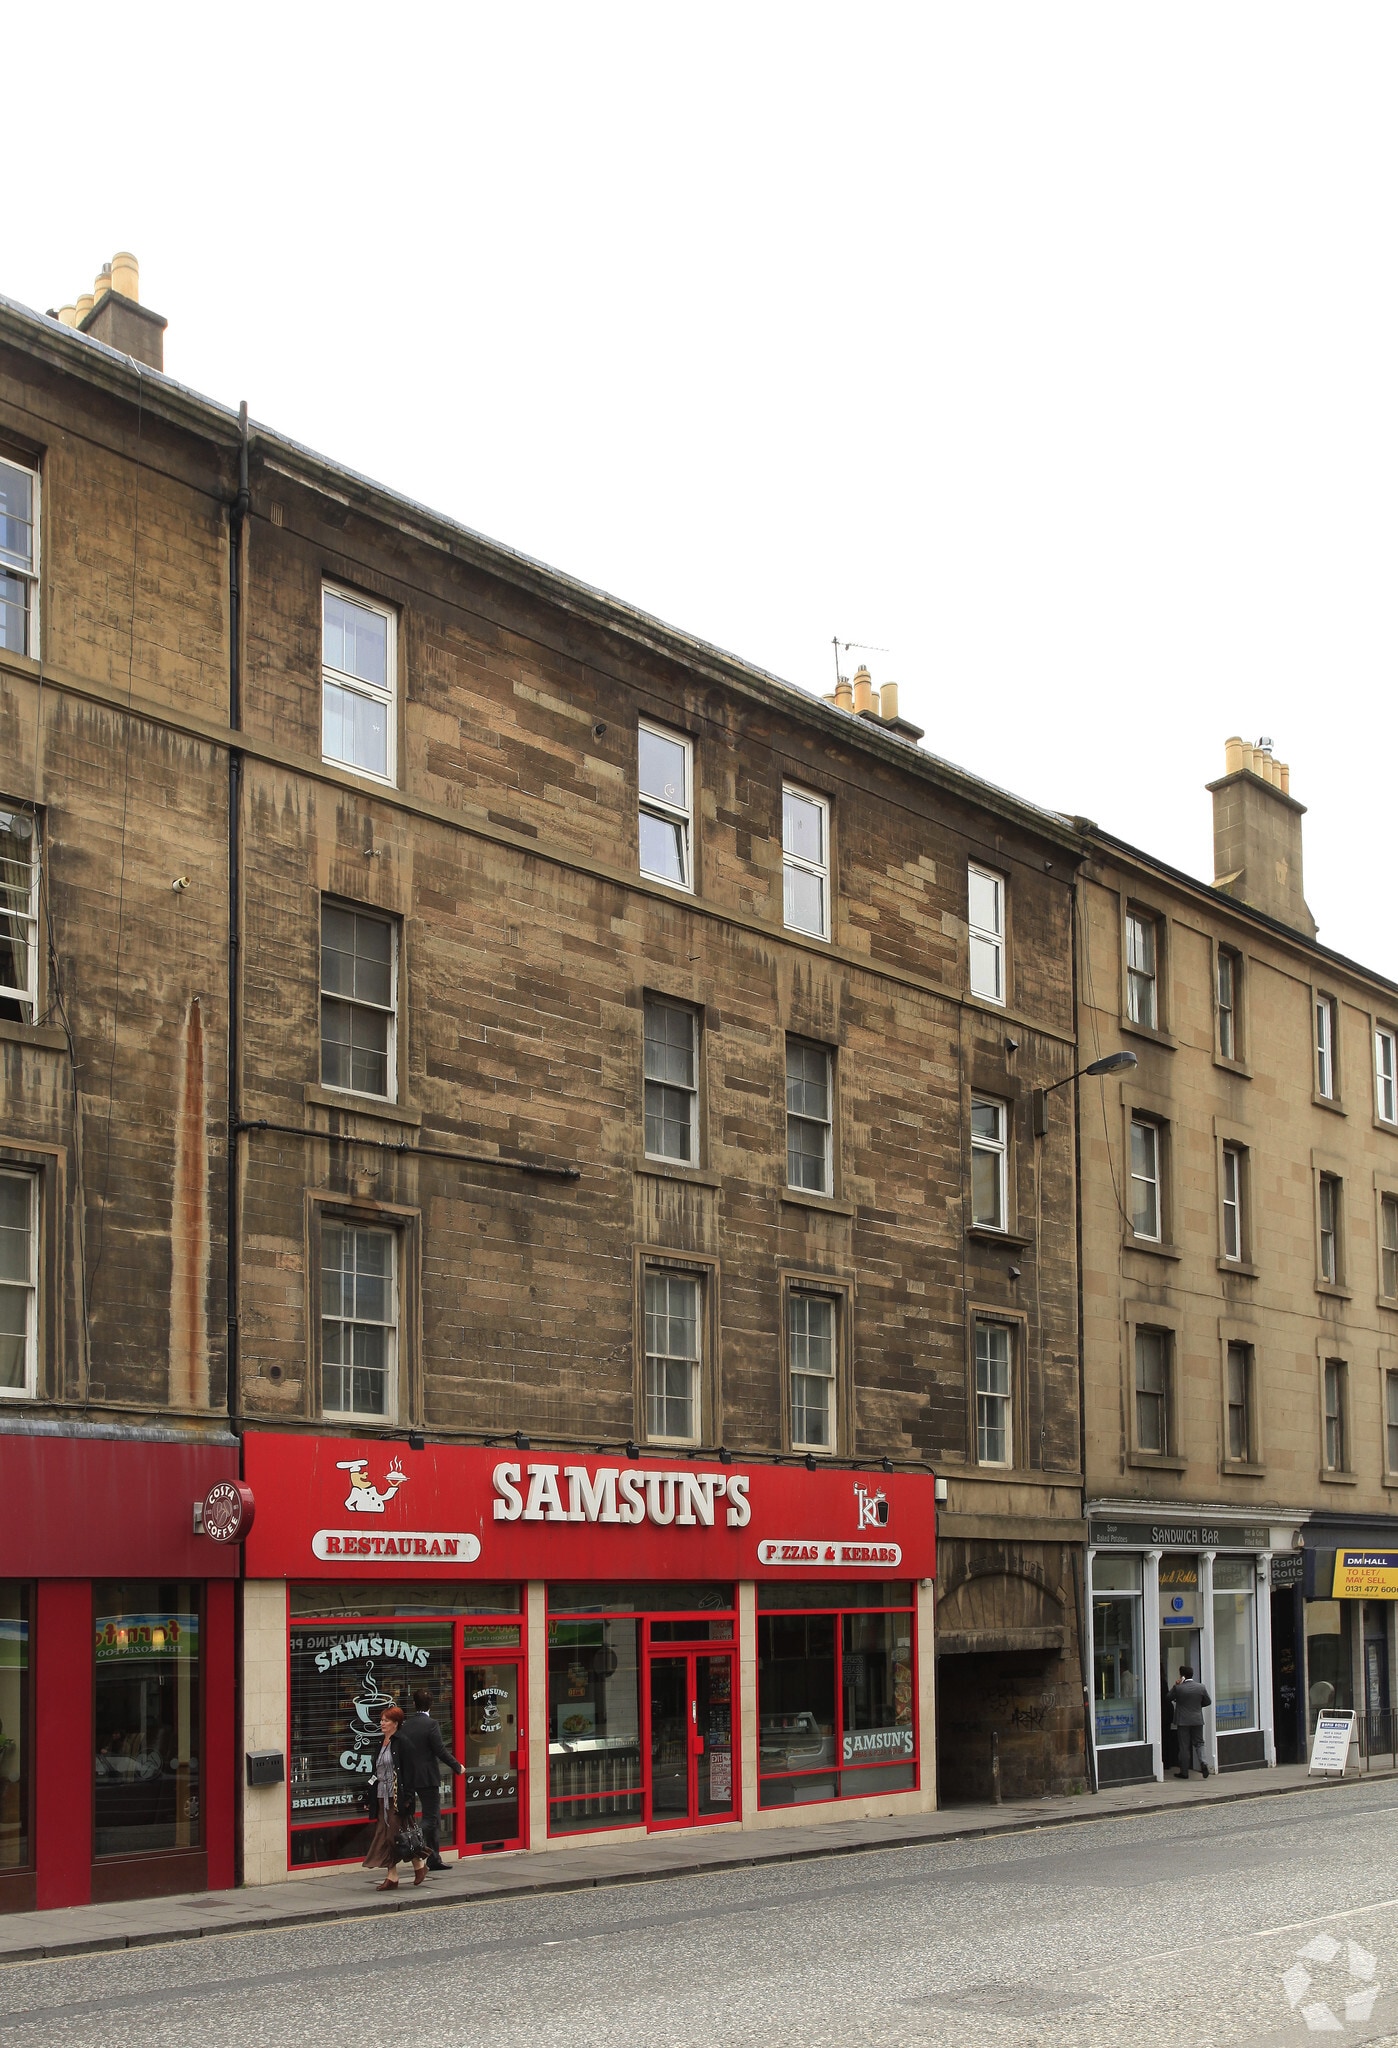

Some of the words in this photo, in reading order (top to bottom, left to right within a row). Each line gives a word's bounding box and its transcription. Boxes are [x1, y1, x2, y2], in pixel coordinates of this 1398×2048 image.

[209, 1486, 235, 1504] COSTA
[492, 1461, 752, 1527] SAMSUN'S
[207, 1516, 238, 1538] COFFEE
[1151, 1526, 1198, 1544] SANDWICH
[1201, 1528, 1220, 1544] BAR
[824, 1546, 836, 1560] &
[841, 1546, 897, 1562] KEBABS
[1272, 1557, 1303, 1569] Rapid
[1272, 1568, 1304, 1579] Rolls
[314, 1638, 430, 1673] SAMSUNS
[472, 1687, 509, 1701] SAMSUNS
[480, 1722, 502, 1732] CAFE
[843, 1731, 914, 1760] SAMSUN'S
[339, 1750, 373, 1773] CA
[292, 1794, 354, 1810] BREAKFAST
